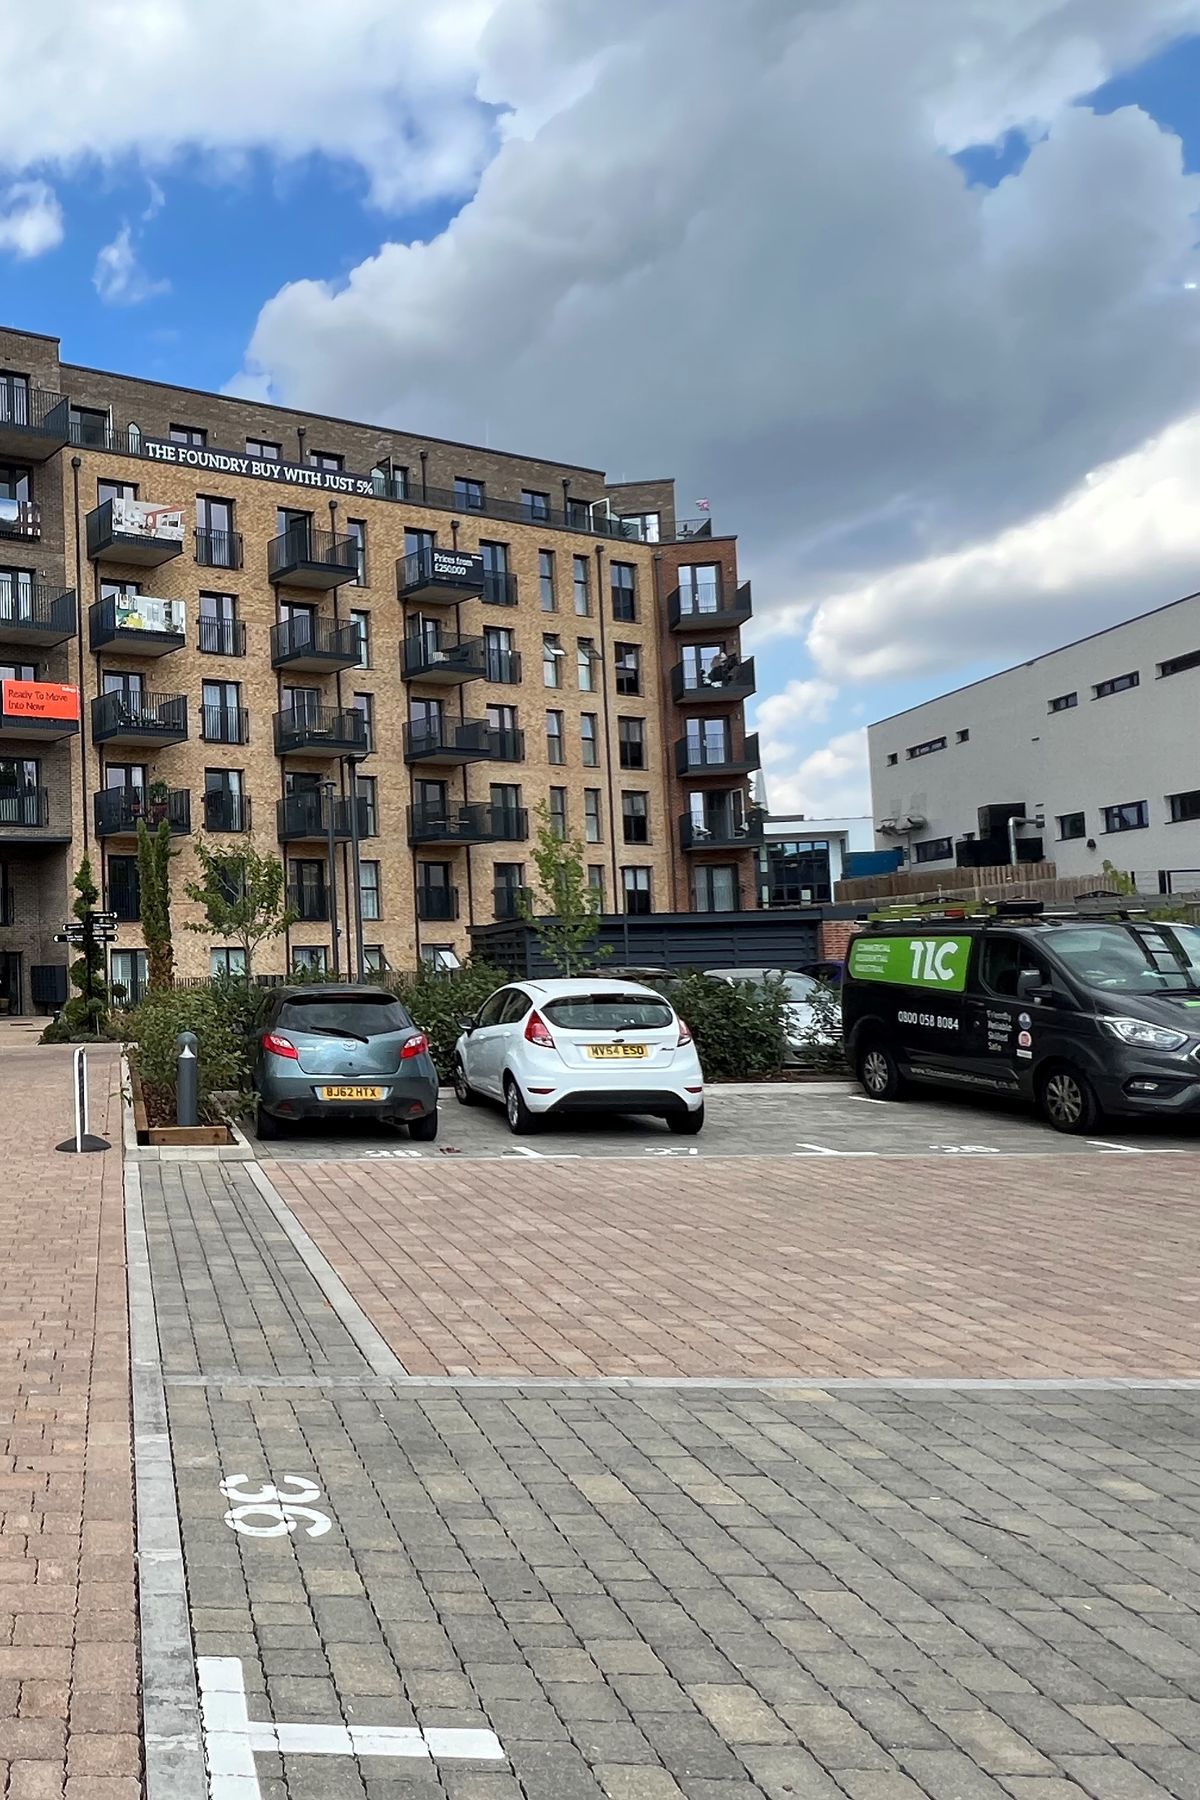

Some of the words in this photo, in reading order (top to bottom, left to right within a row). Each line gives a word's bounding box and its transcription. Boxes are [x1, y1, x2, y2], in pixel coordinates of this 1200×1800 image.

[145, 442, 175, 462] THE
[178, 447, 249, 474] FOUNDRY
[251, 462, 281, 479] BUY
[283, 466, 322, 487] WITH
[324, 473, 355, 492] JUST
[356, 479, 374, 495] 5%
[433, 552, 455, 565] Prices
[456, 556, 474, 567] from
[8, 689, 33, 700] Ready
[35, 690, 45, 700] To
[46, 691, 68, 702] Move
[8, 700, 25, 710] Into
[26, 702, 46, 711] Now
[909, 940, 959, 981] TLC
[897, 1010, 918, 1025] 0800
[919, 1012, 935, 1027] 058
[326, 1087, 354, 1097] BJ62
[355, 1087, 377, 1097] HTX
[218, 1473, 333, 1538] 36
